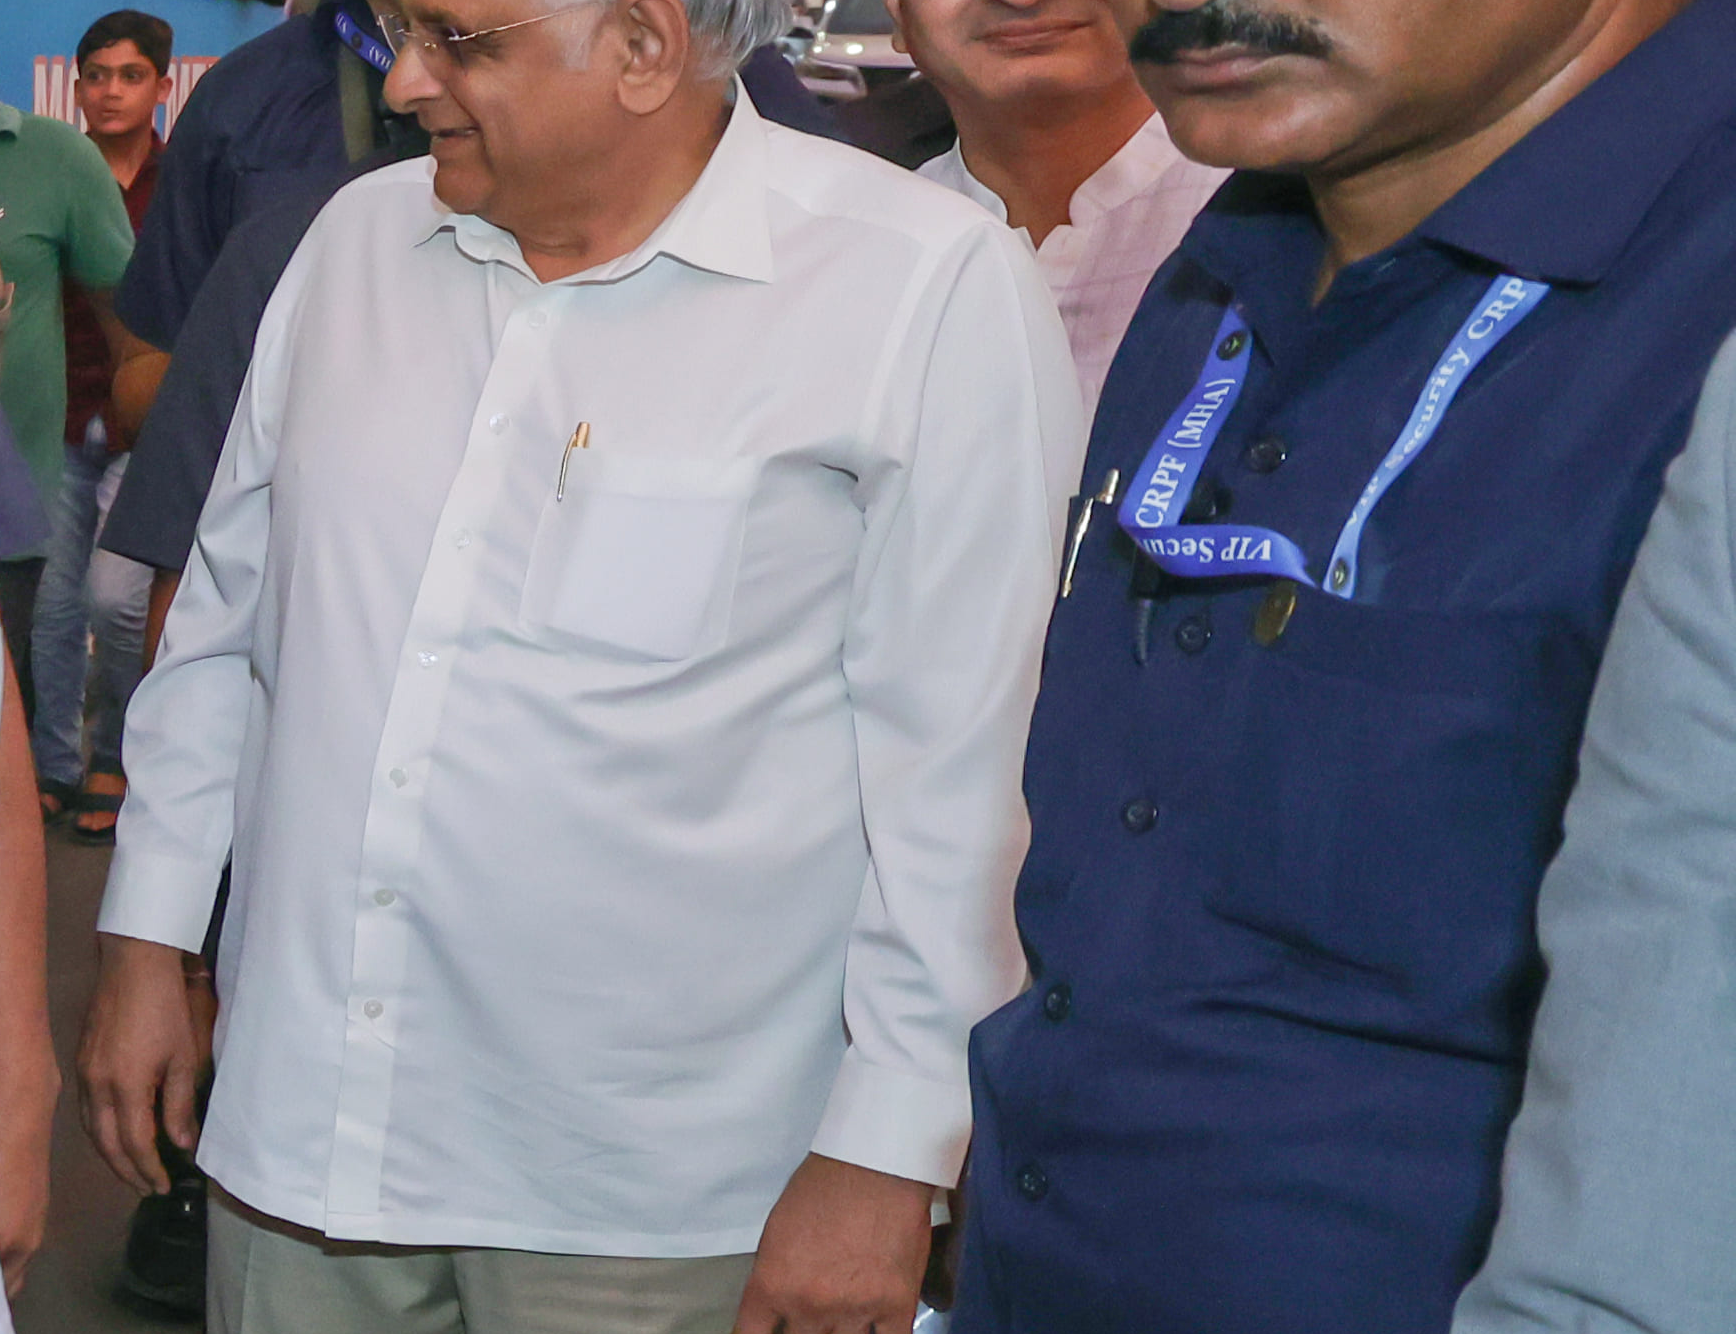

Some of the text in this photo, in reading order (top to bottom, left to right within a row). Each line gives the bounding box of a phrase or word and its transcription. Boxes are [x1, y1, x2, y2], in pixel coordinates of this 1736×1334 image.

[1135, 378, 1236, 529] CRPF (MHA)
[1221, 536, 1272, 561] VIP
